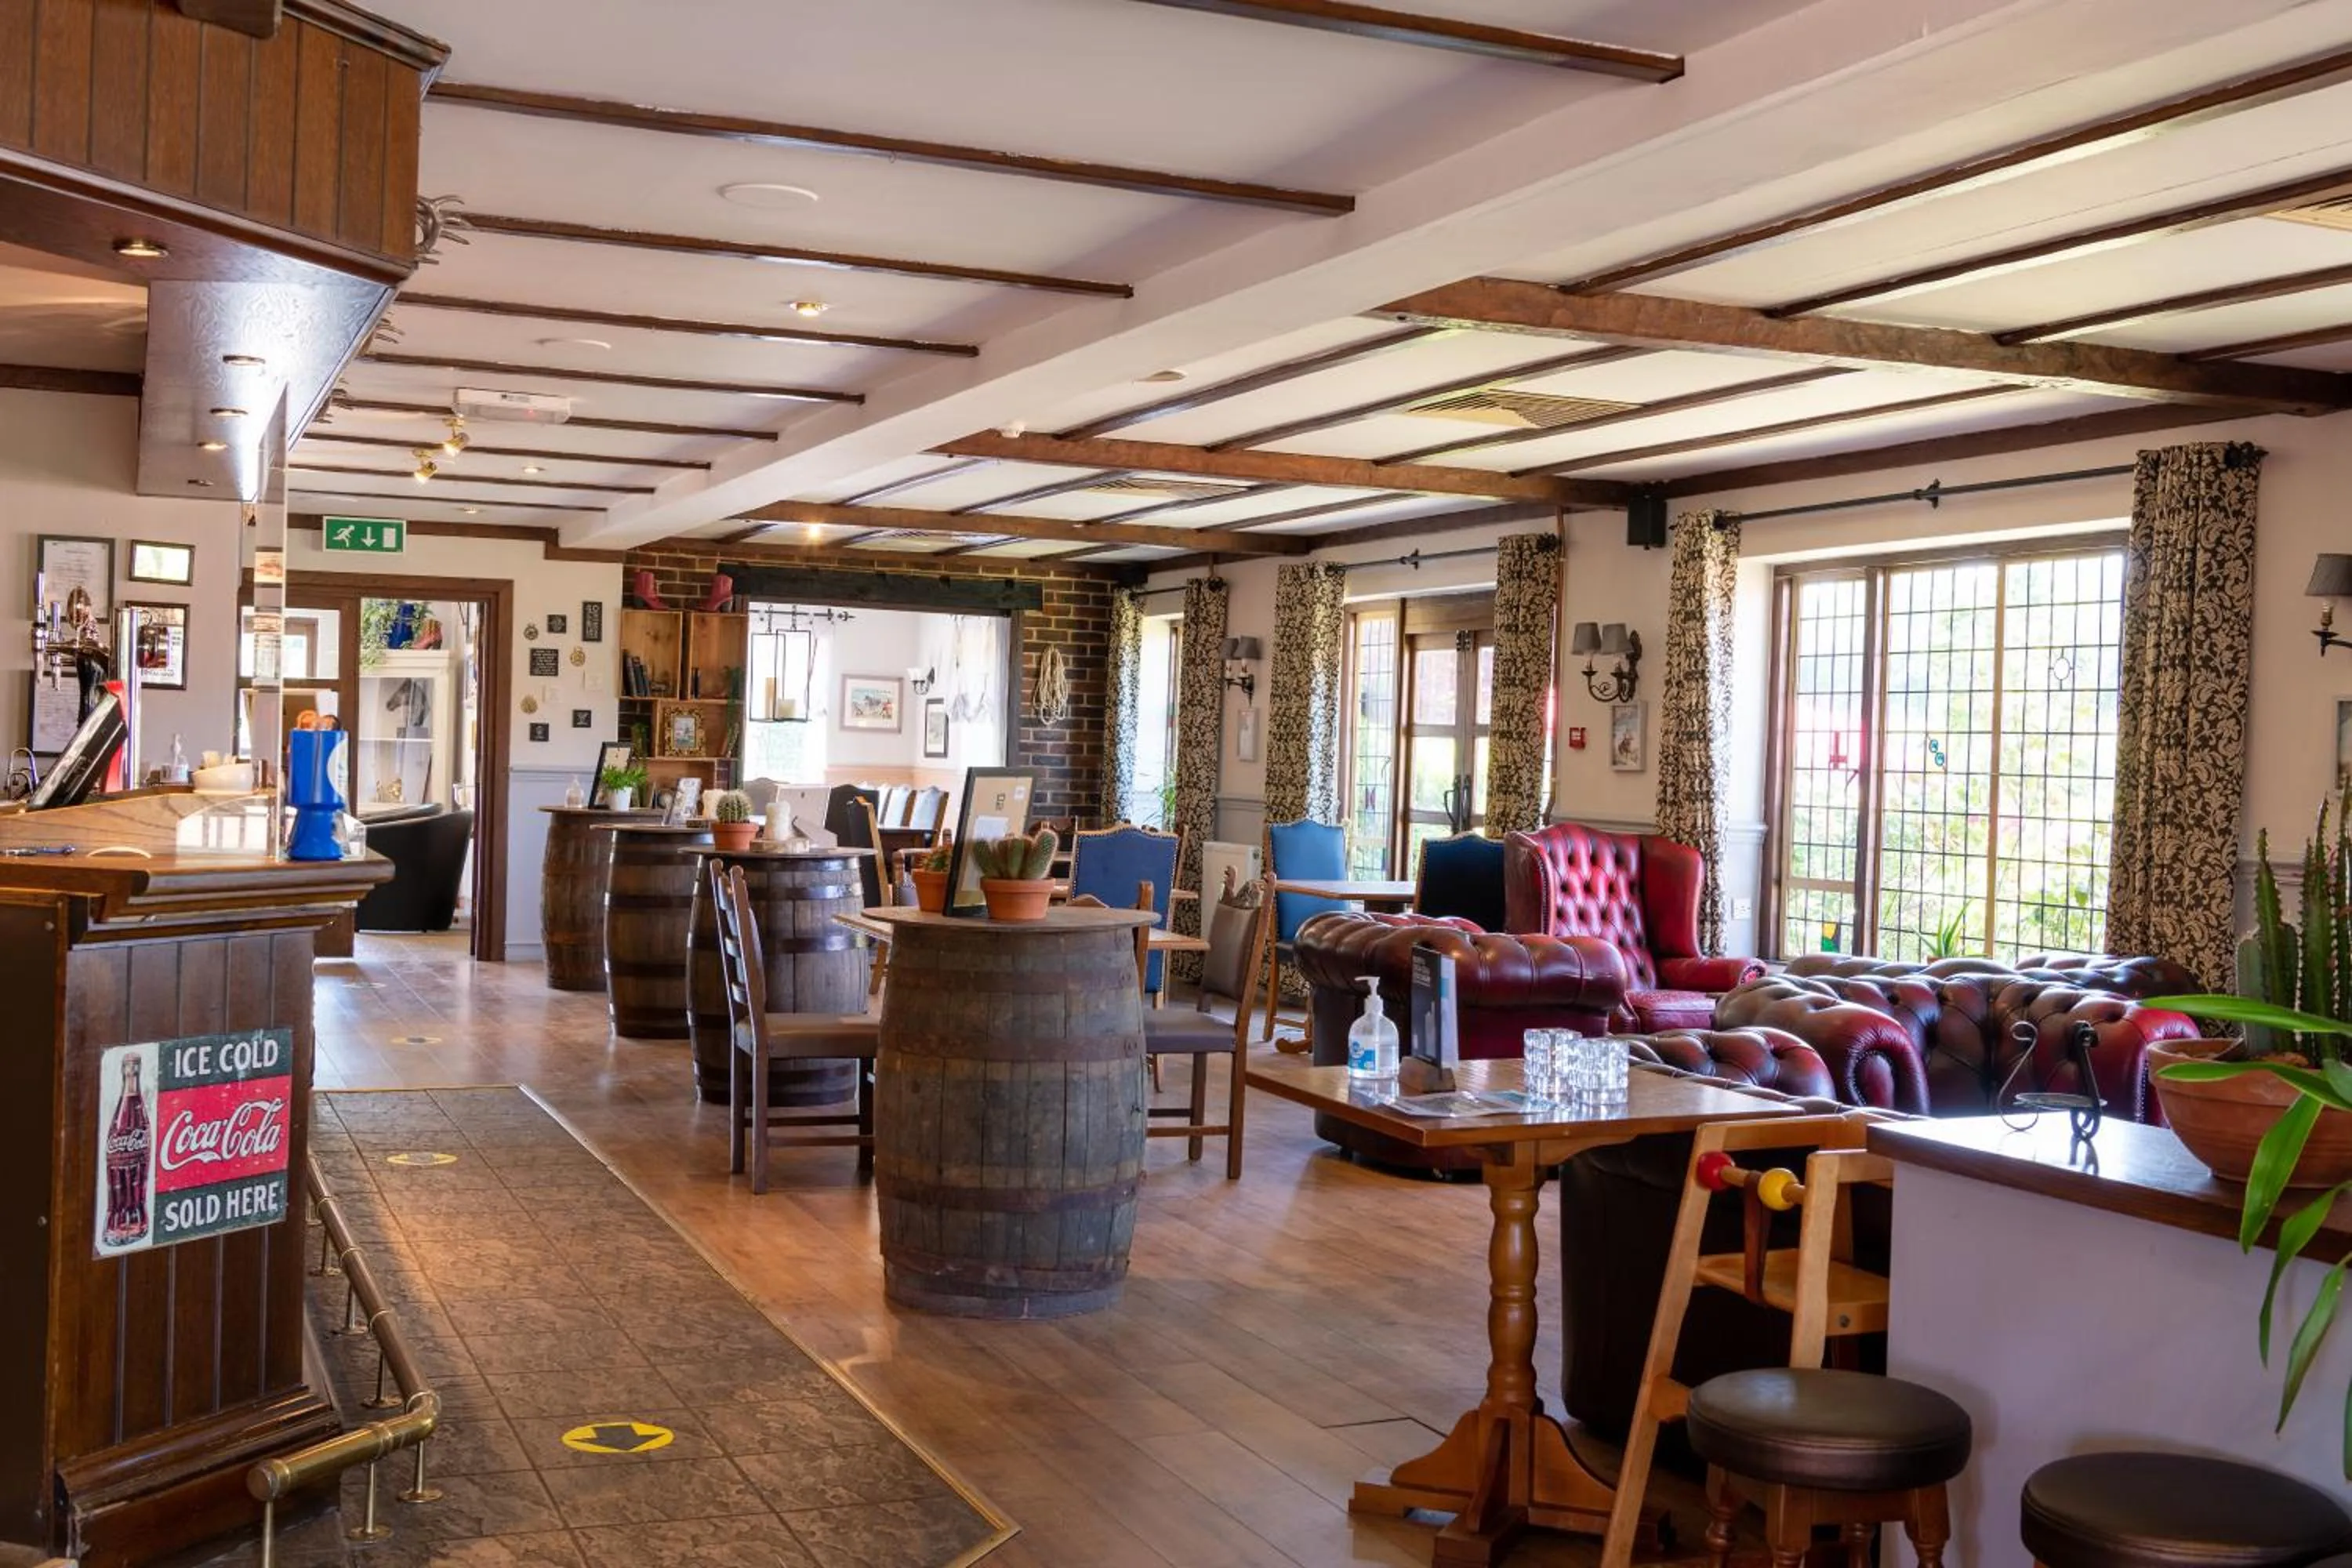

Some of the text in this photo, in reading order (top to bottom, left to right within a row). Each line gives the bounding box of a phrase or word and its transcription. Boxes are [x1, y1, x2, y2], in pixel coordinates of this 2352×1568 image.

[175, 1040, 278, 1078] ICE COLD
[160, 1098, 284, 1171] Coca-Cola
[165, 1181, 278, 1232] SOLD HERE
